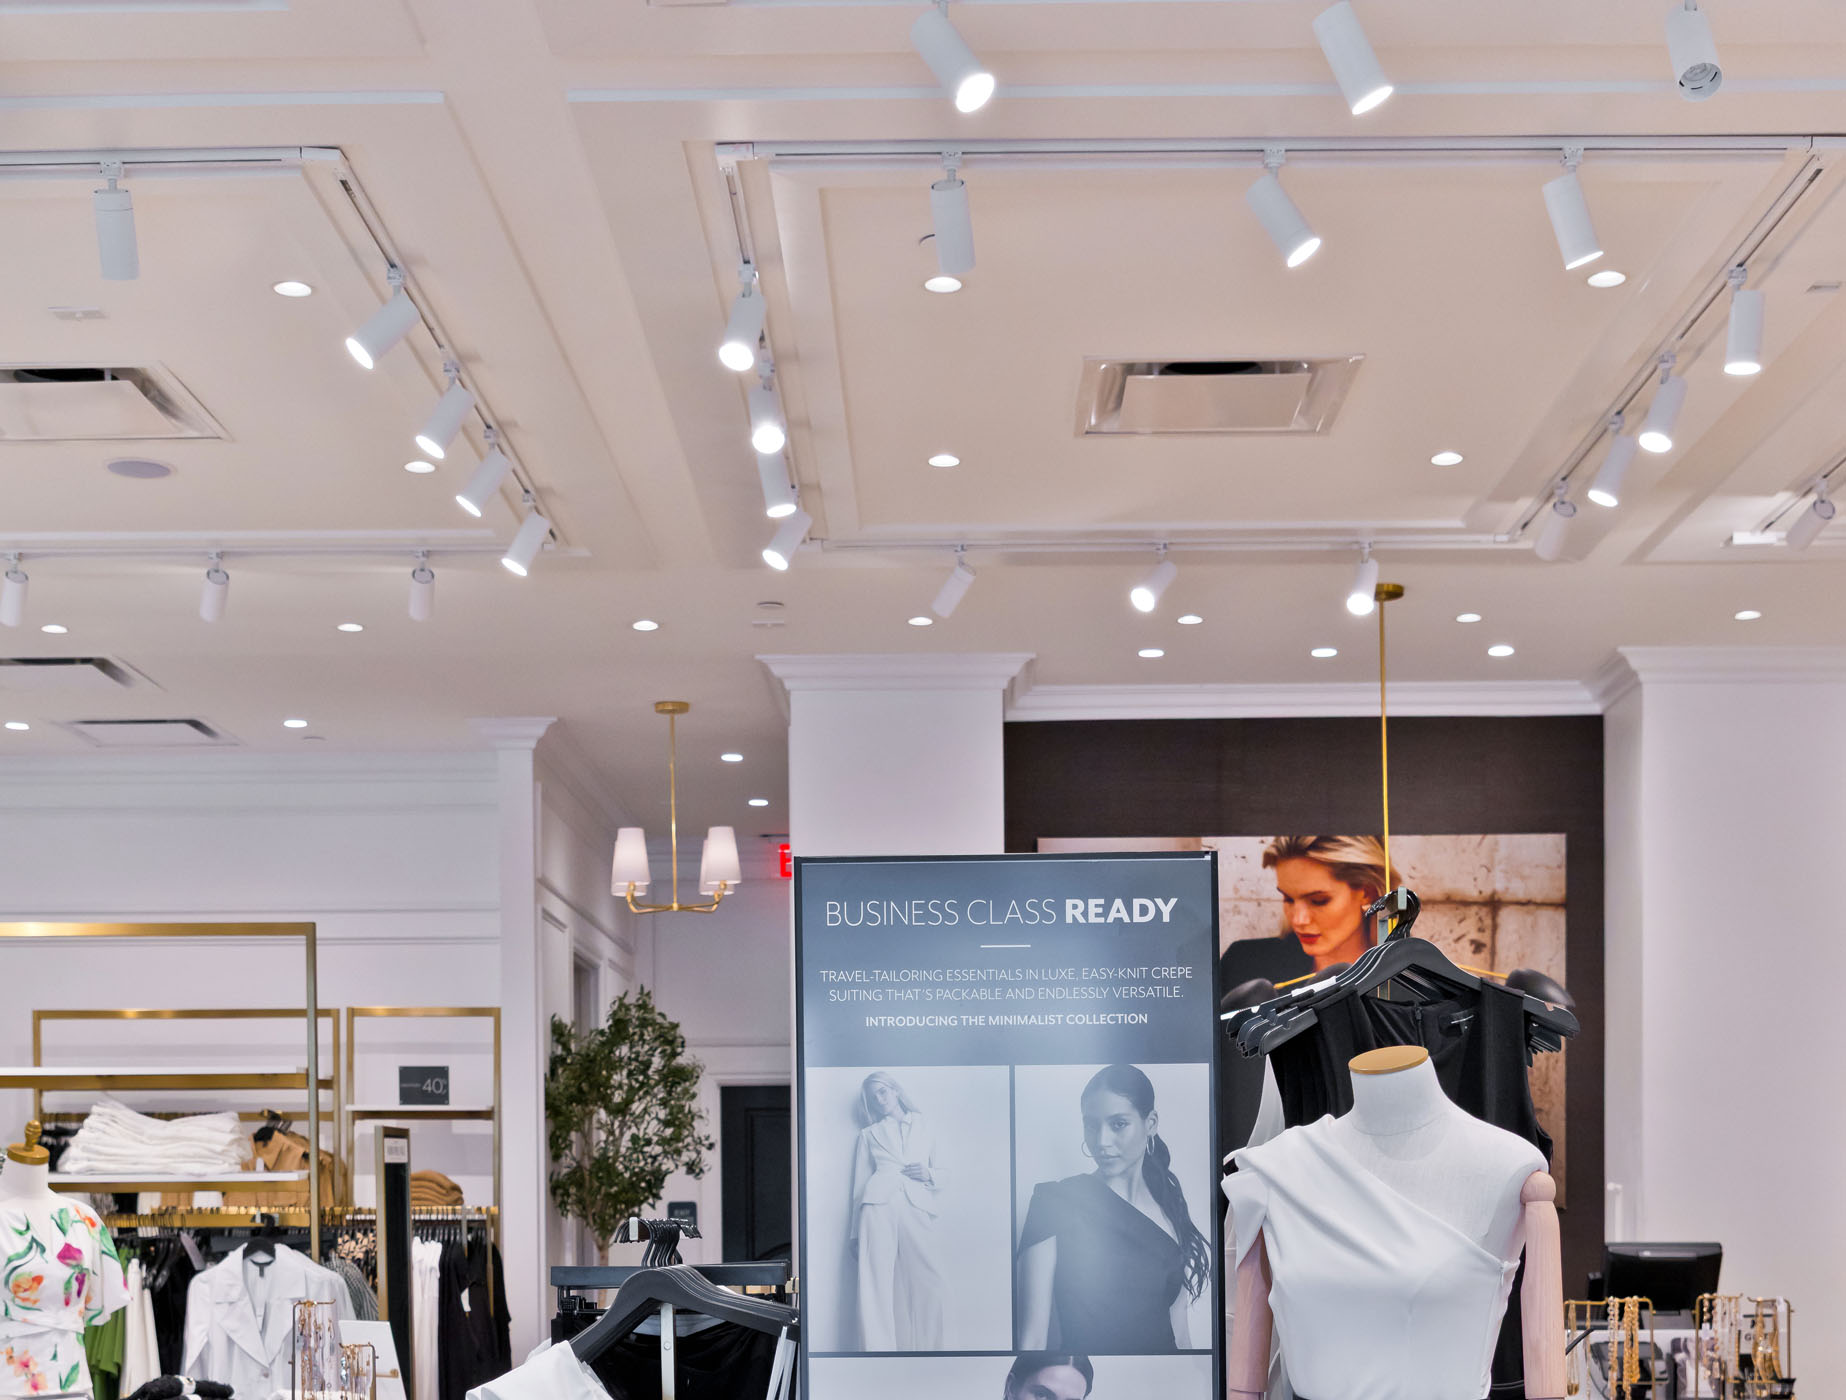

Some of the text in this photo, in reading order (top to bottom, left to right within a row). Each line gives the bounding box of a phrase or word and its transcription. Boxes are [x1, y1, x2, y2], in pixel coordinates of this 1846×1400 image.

[826, 897, 1178, 927] BUSINESS CLASS READY
[819, 966, 1193, 983] TRAVEL-TAILORING ESSENTIALS IN LUXE, EASY-KNIT CREPE
[829, 985, 1184, 1002] SUITING THAT'S PACKABLE AND ENDLESSLY VERSATILE.
[865, 1013, 1148, 1027] INTRODUCING THE MINIMALIST COLLECTION
